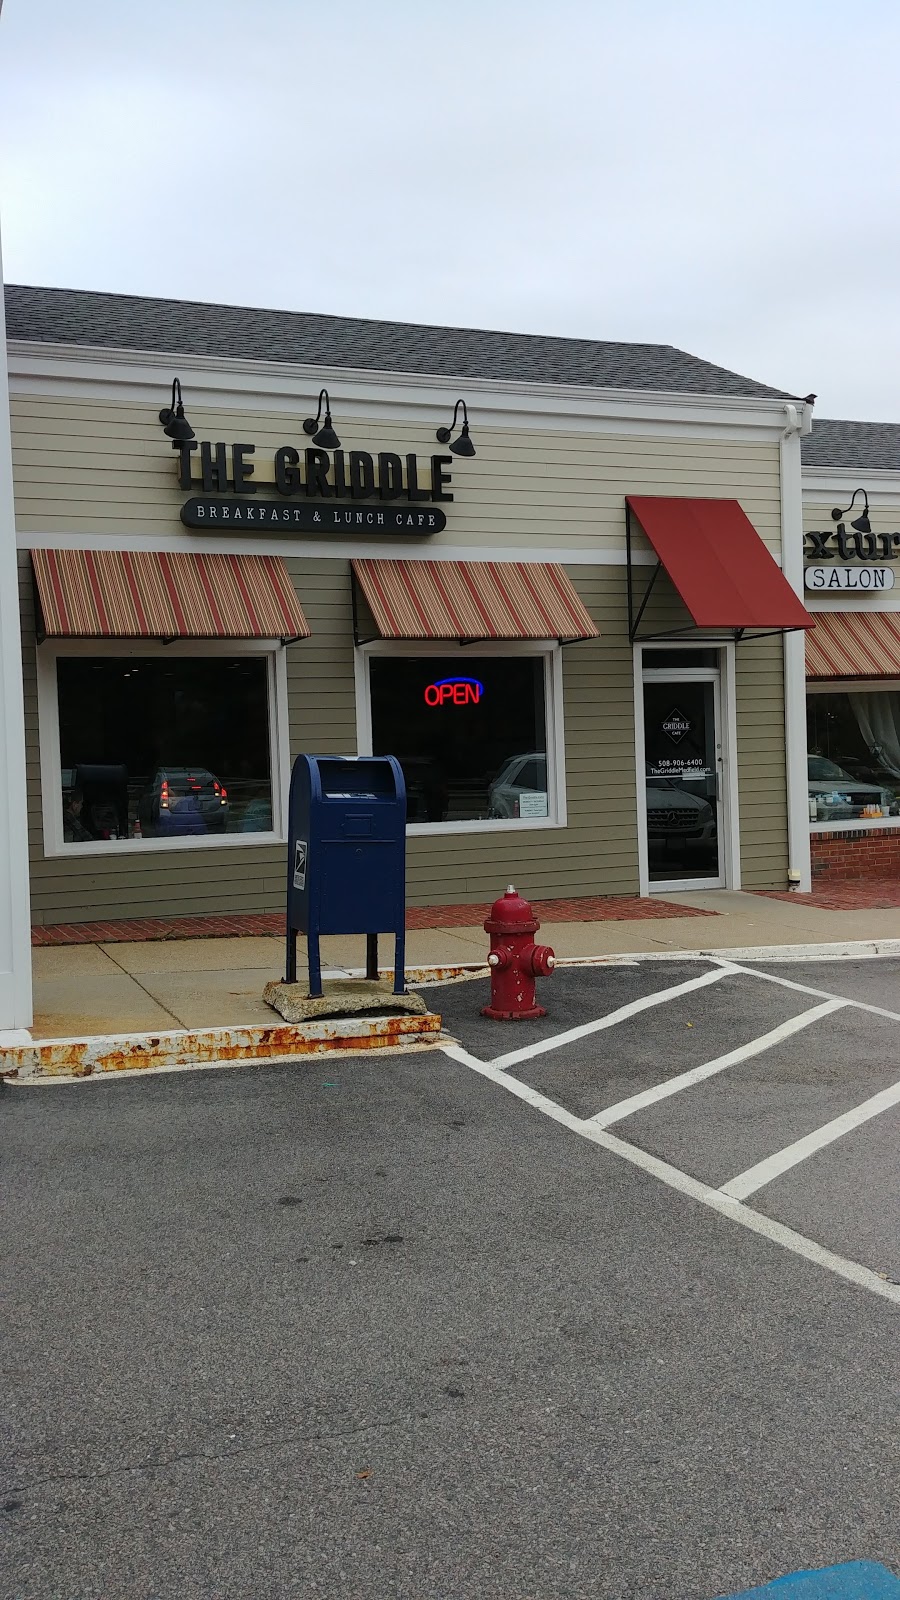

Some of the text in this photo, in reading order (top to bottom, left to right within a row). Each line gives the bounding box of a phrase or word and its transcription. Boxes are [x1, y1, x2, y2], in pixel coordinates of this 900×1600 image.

[172, 440, 454, 502] THE GRIDDLE
[196, 505, 436, 527] BREAKFAST & LUNCH CAFE
[803, 522, 900, 560] xtur
[813, 568, 886, 588] SALON
[424, 683, 480, 706] OPEN
[658, 759, 703, 767] 508-906-6400
